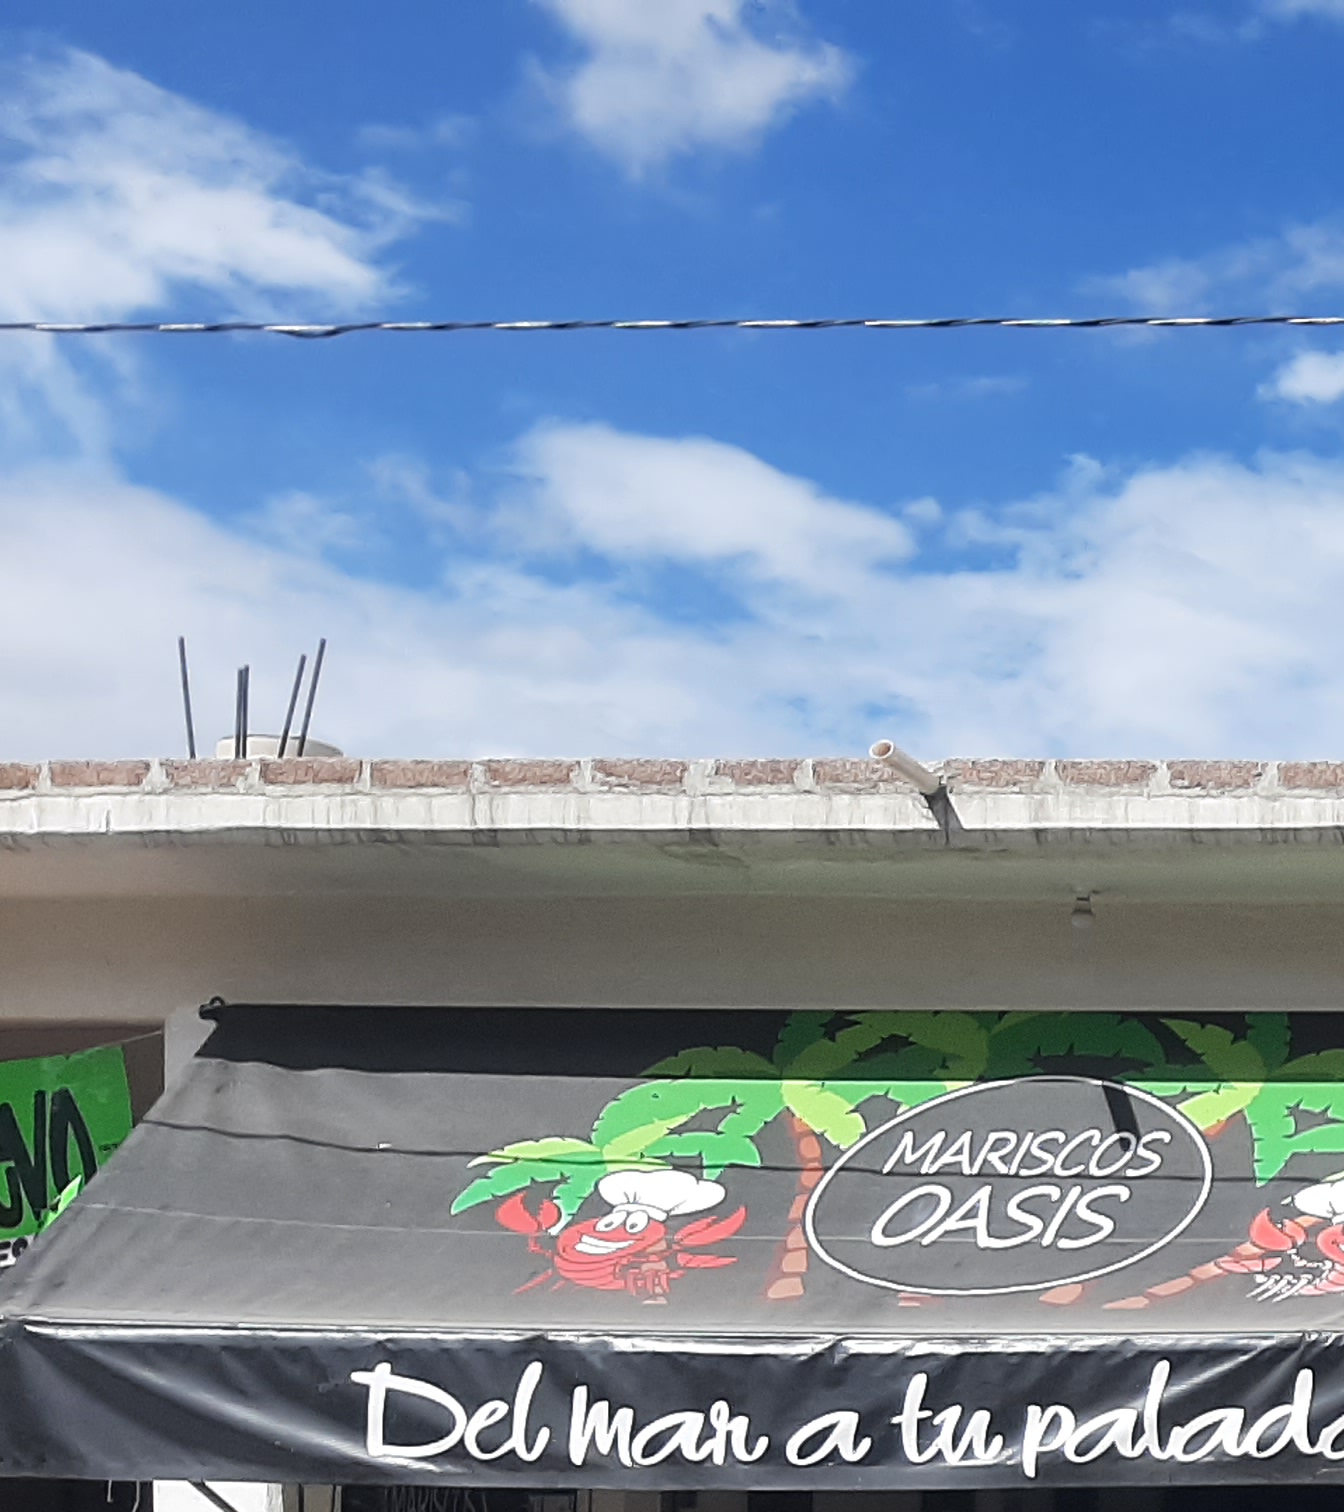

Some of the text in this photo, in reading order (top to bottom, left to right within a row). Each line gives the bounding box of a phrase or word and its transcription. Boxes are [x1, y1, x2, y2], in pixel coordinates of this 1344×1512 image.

[882, 1129, 1172, 1177] MARISCOS
[870, 1184, 1131, 1249] OASIS
[350, 1362, 550, 1462] Del
[568, 1385, 770, 1468] mar
[785, 1409, 872, 1467] a
[890, 1373, 1003, 1464] tu
